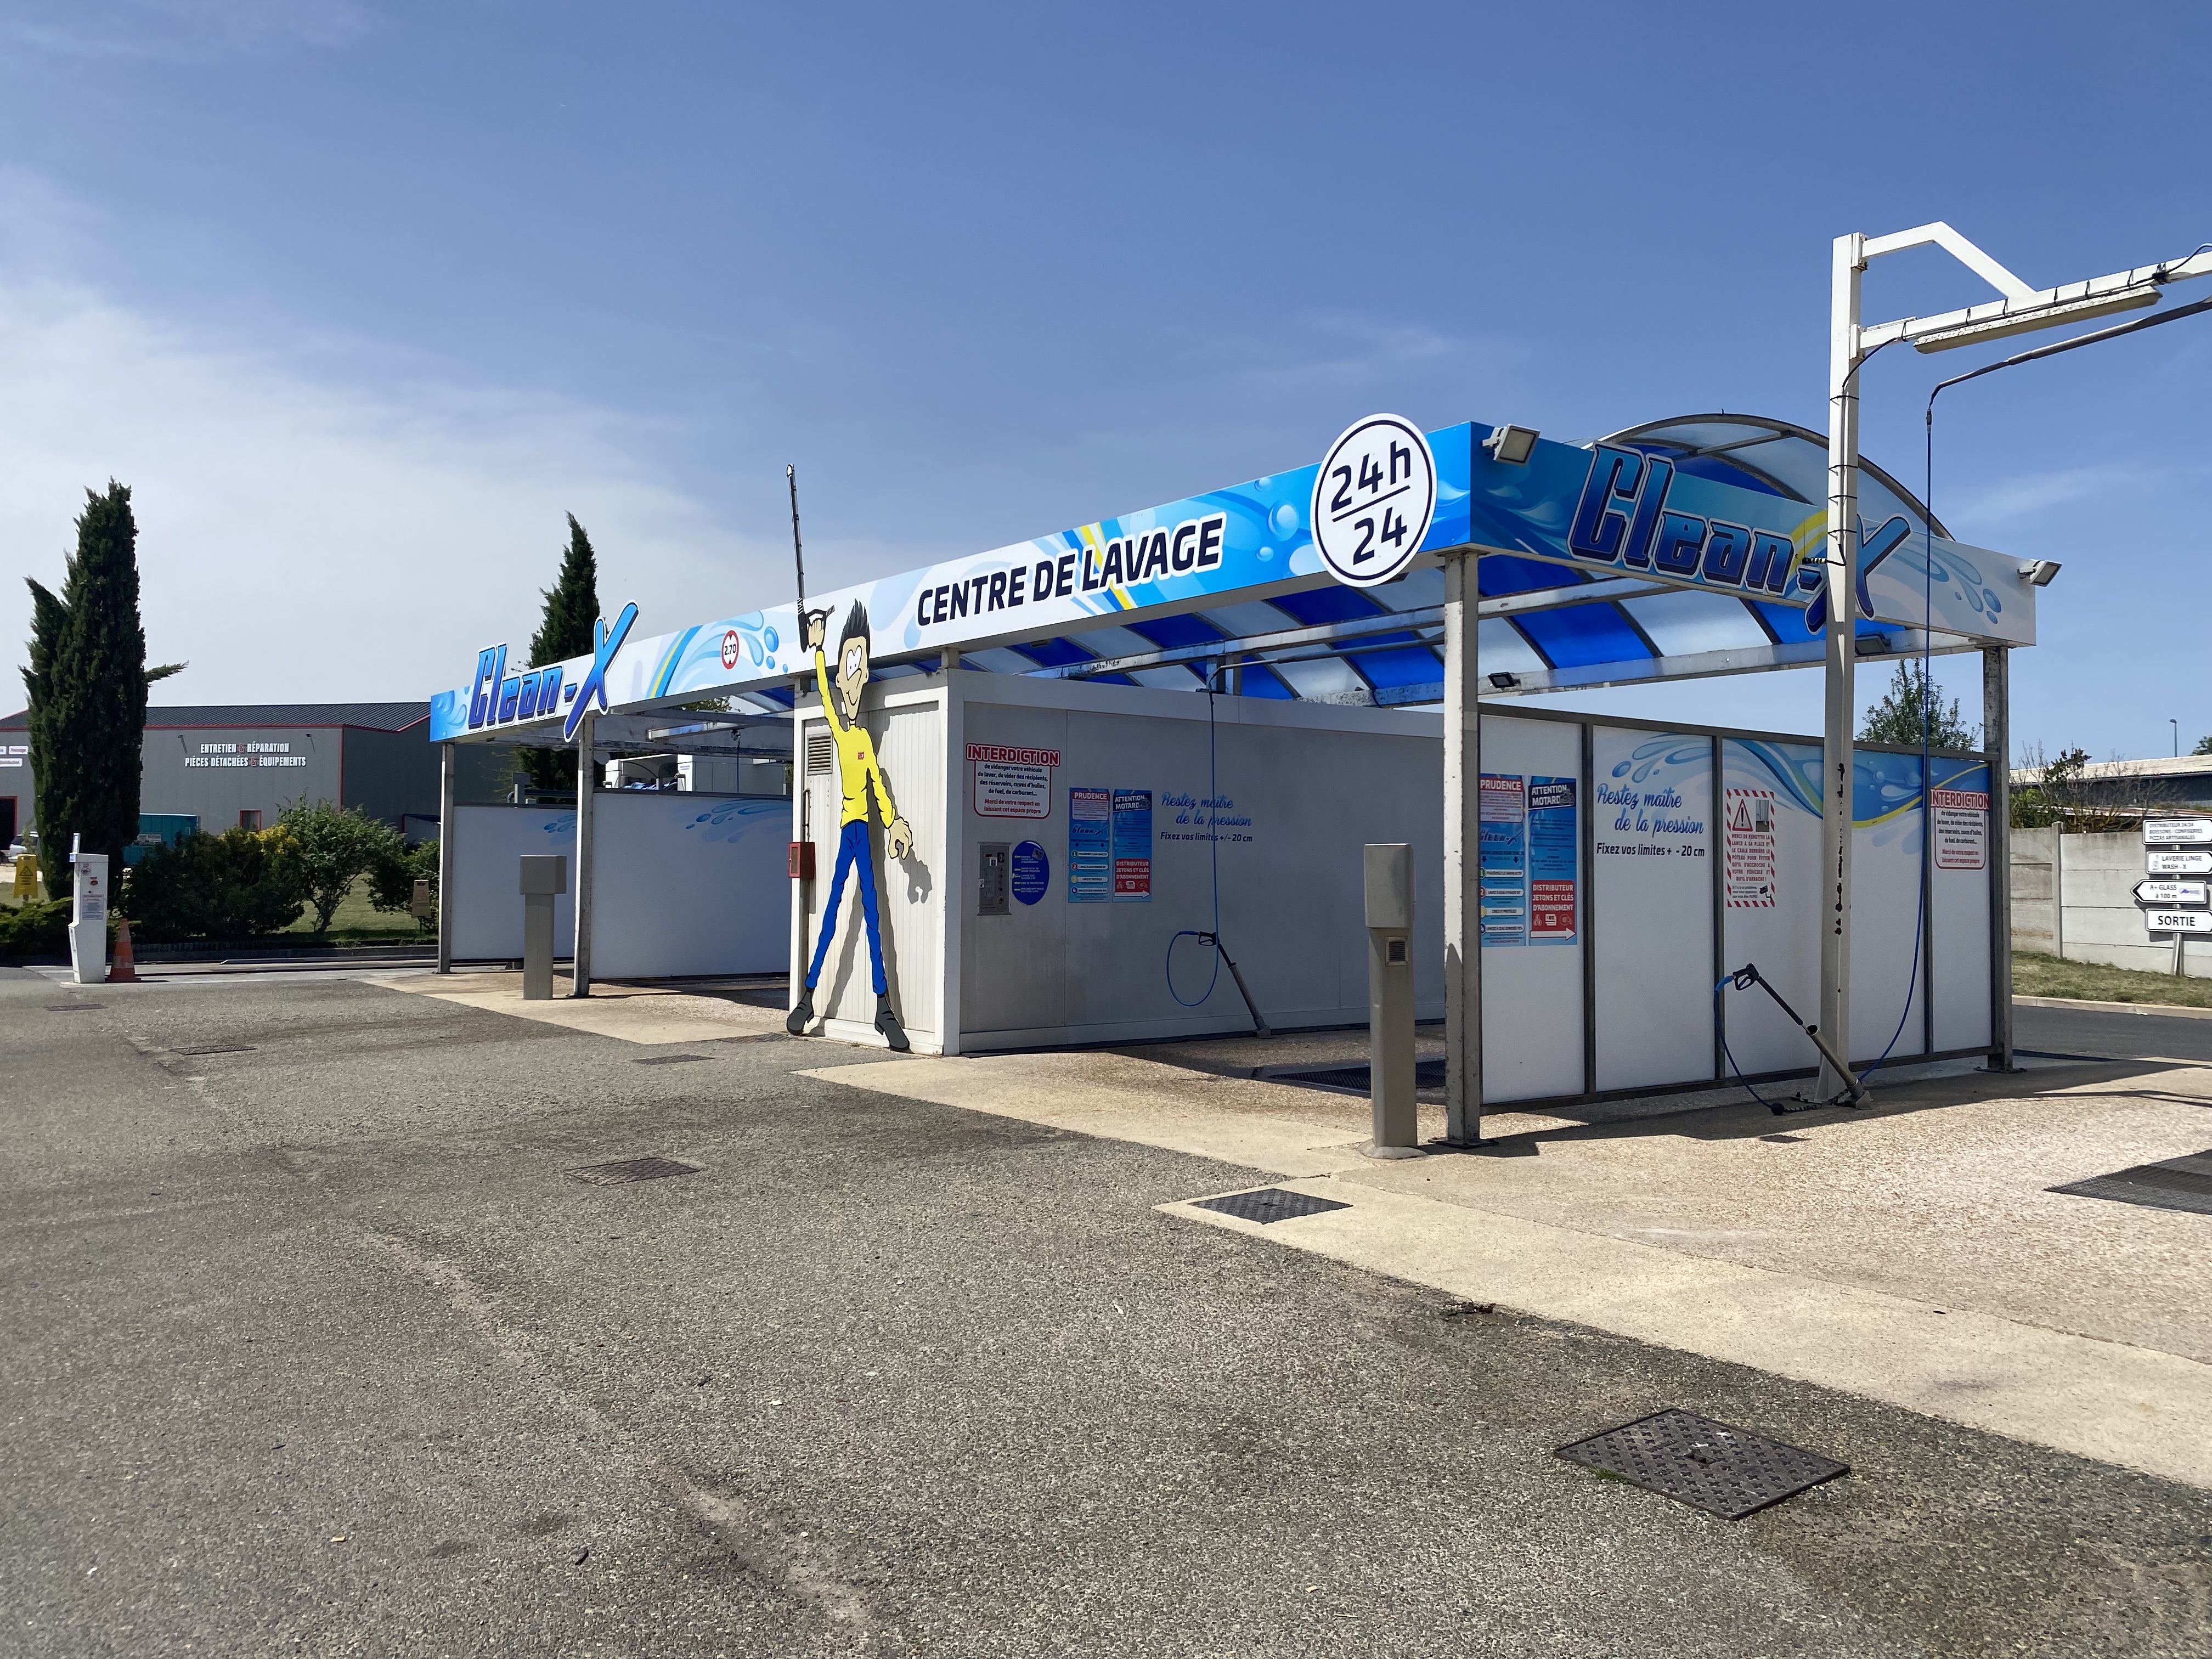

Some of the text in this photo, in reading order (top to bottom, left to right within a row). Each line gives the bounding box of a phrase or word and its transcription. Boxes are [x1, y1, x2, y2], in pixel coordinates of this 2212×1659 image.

[1331, 440, 1410, 513] 24h
[1353, 506, 1407, 565] 24
[917, 518, 1223, 627] CENTRE DE LAVAGE
[724, 644, 736, 656] 2.70
[467, 601, 639, 740] Clean-X
[200, 741, 289, 753] ENTRETIEN & RÉPARATION
[967, 744, 1059, 766] INTERDICTION
[185, 754, 306, 767] PIÈCES DÉTACHÉES & ÉQUIPEMENTS
[989, 779, 1013, 788] réservoirs,
[1480, 779, 1521, 791] PRUDENCE
[1531, 784, 1567, 795] ATTENTION
[1161, 792, 1197, 810] Restez
[1597, 783, 1682, 810] Restez maître
[1931, 790, 1989, 810] NTERDICTION
[1176, 808, 1252, 830] de la pression
[1615, 807, 1704, 838] de la pression
[1160, 832, 1180, 840] Fixez
[1195, 832, 1218, 841] limites
[1596, 842, 1620, 854] Fixez
[1622, 846, 1636, 855] vos
[1638, 844, 1665, 855] limites
[1681, 845, 1692, 856] 20
[1694, 848, 1705, 857] cm
[1561, 893, 1574, 901] CLÉS
[2158, 916, 2196, 926] SORTIE
